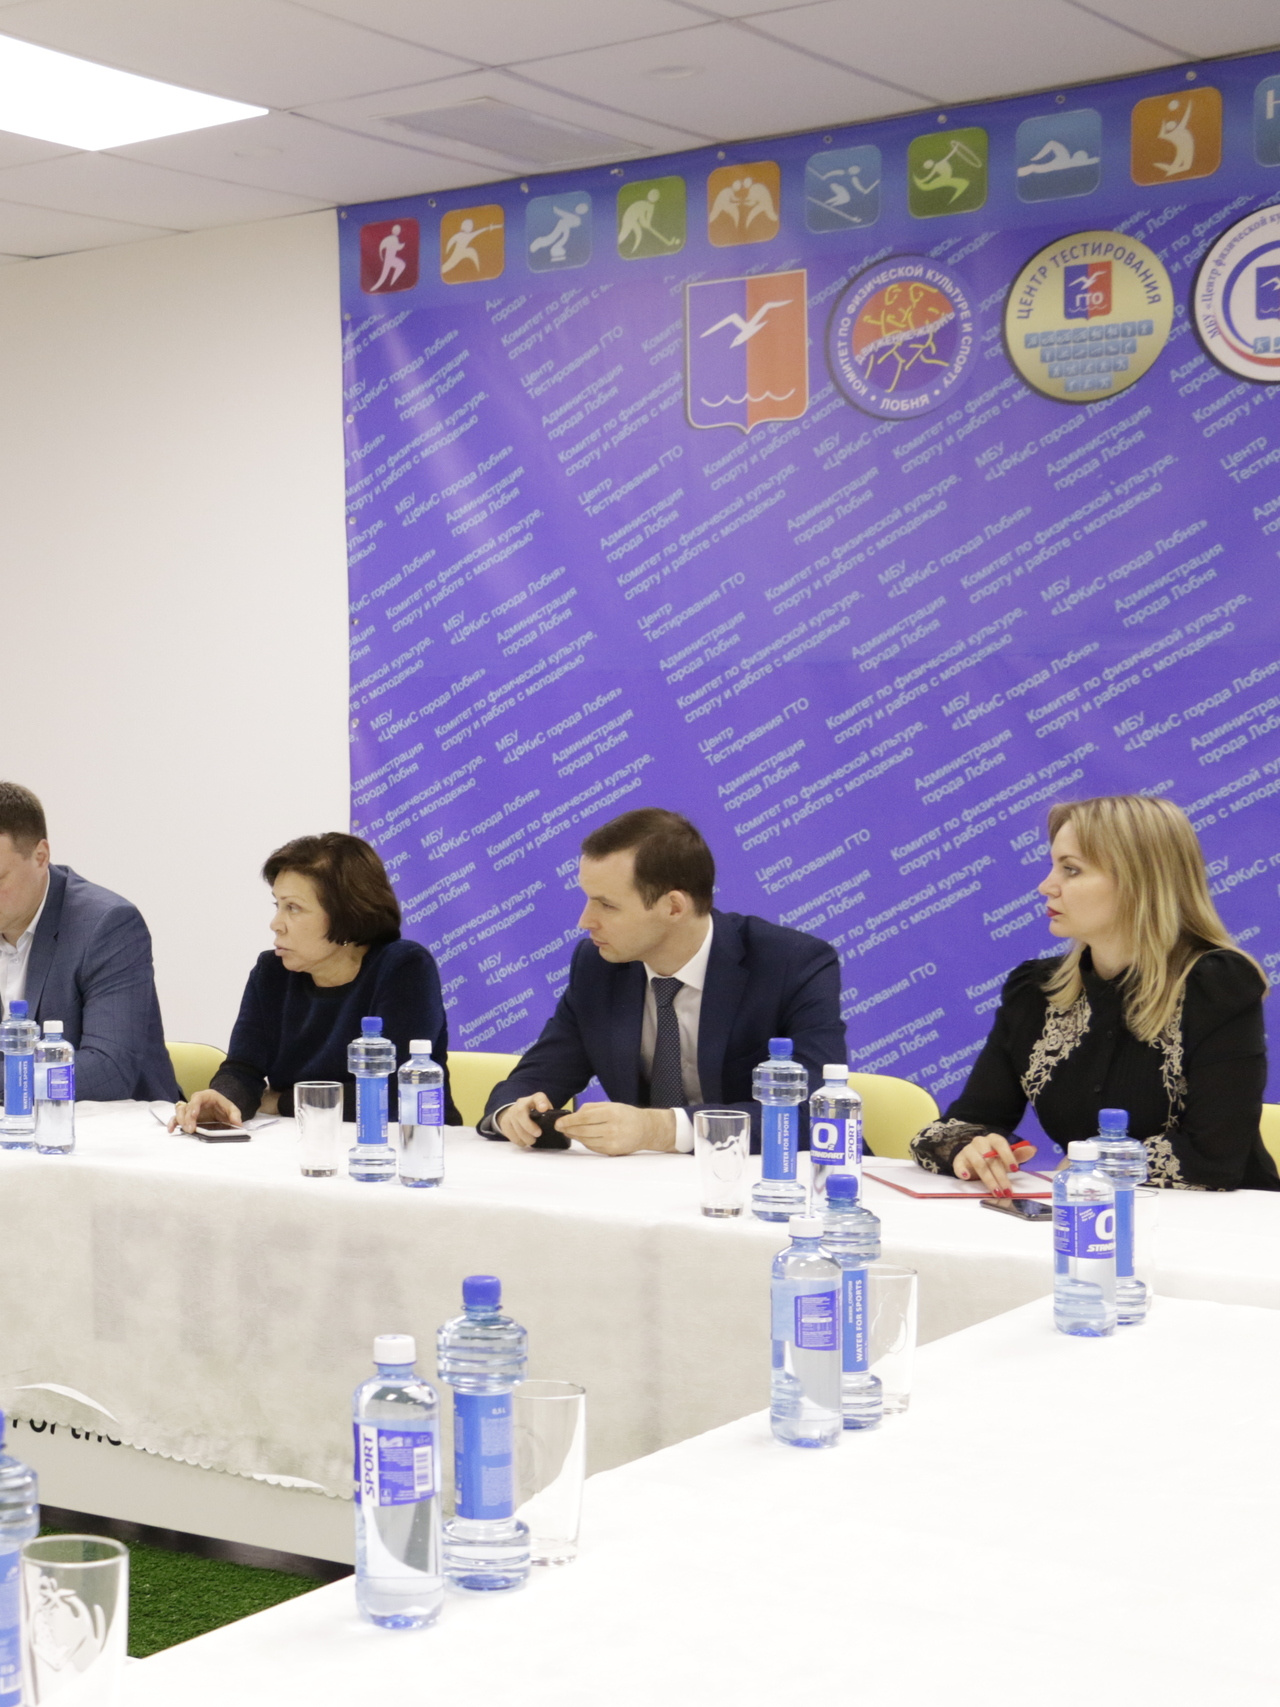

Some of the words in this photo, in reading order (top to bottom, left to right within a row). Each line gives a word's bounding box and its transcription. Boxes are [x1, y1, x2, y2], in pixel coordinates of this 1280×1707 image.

[846, 265, 924, 314] ФИЗИЧЕСКОЙ
[926, 269, 971, 320] КУЛЬТУРЕ
[1017, 266, 1048, 319] ЦЕНТР
[1050, 242, 1161, 305] ТЕСТИРОВАНИЯ
[1075, 292, 1103, 307] ГТО
[1201, 314, 1220, 339] МБУ
[1213, 213, 1268, 266] физической
[838, 317, 851, 337] ПО
[962, 323, 973, 332] И
[389, 356, 424, 383] города
[424, 330, 458, 359] Лобня»
[394, 350, 470, 408] Администрация
[521, 360, 554, 387] Центр
[527, 345, 599, 398] Тестирования
[600, 327, 622, 347] ГТО
[838, 340, 868, 396] КОМИТЕТ
[943, 336, 972, 388] СПОРТУ
[342, 378, 366, 401] МБУ
[400, 394, 435, 421] города
[436, 370, 465, 397] Лобня
[542, 365, 623, 427] Администрация
[548, 411, 584, 440] города
[584, 387, 618, 414] Лобня
[880, 394, 930, 411] ЛОБНЯ
[387, 422, 443, 467] физической
[445, 391, 489, 425] культуре,
[558, 429, 601, 462] Комитет
[603, 419, 617, 432] по
[566, 448, 601, 476] спорту
[602, 442, 610, 451] и
[611, 415, 649, 447] работе
[813, 433, 839, 457] МБУ
[1047, 405, 1152, 476] Администрация
[402, 493, 440, 527] «ЦФКиС
[441, 472, 477, 498] города
[477, 446, 513, 475] Лобня»
[584, 464, 659, 517] Тестирования
[659, 446, 683, 467] ГТО
[1054, 458, 1100, 490] города
[1101, 430, 1145, 462] Лобня
[395, 493, 415, 514] МБУ
[446, 466, 524, 524] Администрация
[451, 510, 488, 537] города
[488, 487, 520, 514] Лобня
[578, 478, 612, 505] Центр
[600, 488, 684, 550] Администрация
[606, 534, 644, 563] города
[644, 510, 679, 538] Лобня
[960, 552, 1013, 588] Комитет
[1015, 541, 1032, 555] по
[1034, 490, 1112, 544] физической
[1114, 455, 1178, 495] культуре,
[970, 573, 1012, 603] спорту
[1014, 566, 1024, 576] и
[1025, 537, 1071, 572] работе
[1083, 482, 1162, 534] молодежью
[878, 560, 905, 584] МБУ
[888, 561, 938, 598] «ЦФКиС
[940, 535, 984, 566] города
[984, 506, 1032, 539] Лобня»
[1051, 577, 1106, 615] «ЦФКиС
[1108, 550, 1155, 582] города
[1155, 520, 1207, 554] Лобня»
[1115, 544, 1224, 612] Администрация
[450, 612, 490, 645] «ЦФКиС
[491, 591, 527, 618] города
[528, 566, 566, 595] Лобня»
[497, 587, 577, 644] Администрация
[637, 603, 672, 629] Центр
[643, 590, 721, 642] Тестирования
[720, 572, 745, 593] ГТО
[1040, 576, 1070, 601] МБУ
[1122, 596, 1171, 627] города
[1171, 568, 1217, 600] Лобня
[442, 611, 464, 632] МБУ
[502, 630, 538, 657] города
[538, 608, 572, 634] Лобня
[659, 612, 745, 671] Администрация
[852, 596, 946, 659] Администрация
[859, 644, 900, 672] города
[901, 619, 940, 648] Лобня
[666, 657, 704, 685] города
[704, 634, 740, 661] Лобня
[952, 693, 1005, 730] «ЦФКиС
[1005, 669, 1051, 700] города
[1051, 642, 1099, 674] Лобня»
[1026, 687, 1081, 723] Комитет
[1083, 677, 1101, 691] по
[1102, 628, 1183, 681] физической
[1184, 594, 1252, 634] культуре,
[1035, 708, 1079, 738] спорту
[1081, 702, 1092, 713] и
[1093, 674, 1141, 709] работе
[1152, 622, 1235, 672] молодежью
[503, 732, 546, 764] «ЦФКиС
[546, 711, 583, 738] города
[582, 688, 622, 716] Лобня»
[704, 715, 784, 766] Тестирования
[783, 698, 809, 719] ГТО
[941, 692, 970, 716] МБУ
[495, 729, 518, 752] МБУ
[698, 727, 734, 753] Центр
[915, 729, 1013, 791] Администрация
[718, 739, 806, 798] Администрация
[724, 784, 762, 811] города
[762, 761, 800, 789] Лобня
[921, 776, 965, 805] города
[964, 752, 1006, 781] Лобня
[428, 830, 470, 861] «ЦФКиС
[471, 811, 504, 836] города
[503, 789, 540, 816] Лобня»
[755, 856, 793, 882] Центр
[762, 845, 845, 895] Тестирования
[844, 829, 870, 850] ГТО
[778, 869, 871, 926] Администрация
[458, 988, 534, 1036] Администрация
[464, 1026, 496, 1047] города
[496, 1008, 528, 1031] Лобня
[849, 1007, 945, 1062] Администрация
[364, 1433, 375, 1499] SPORT
